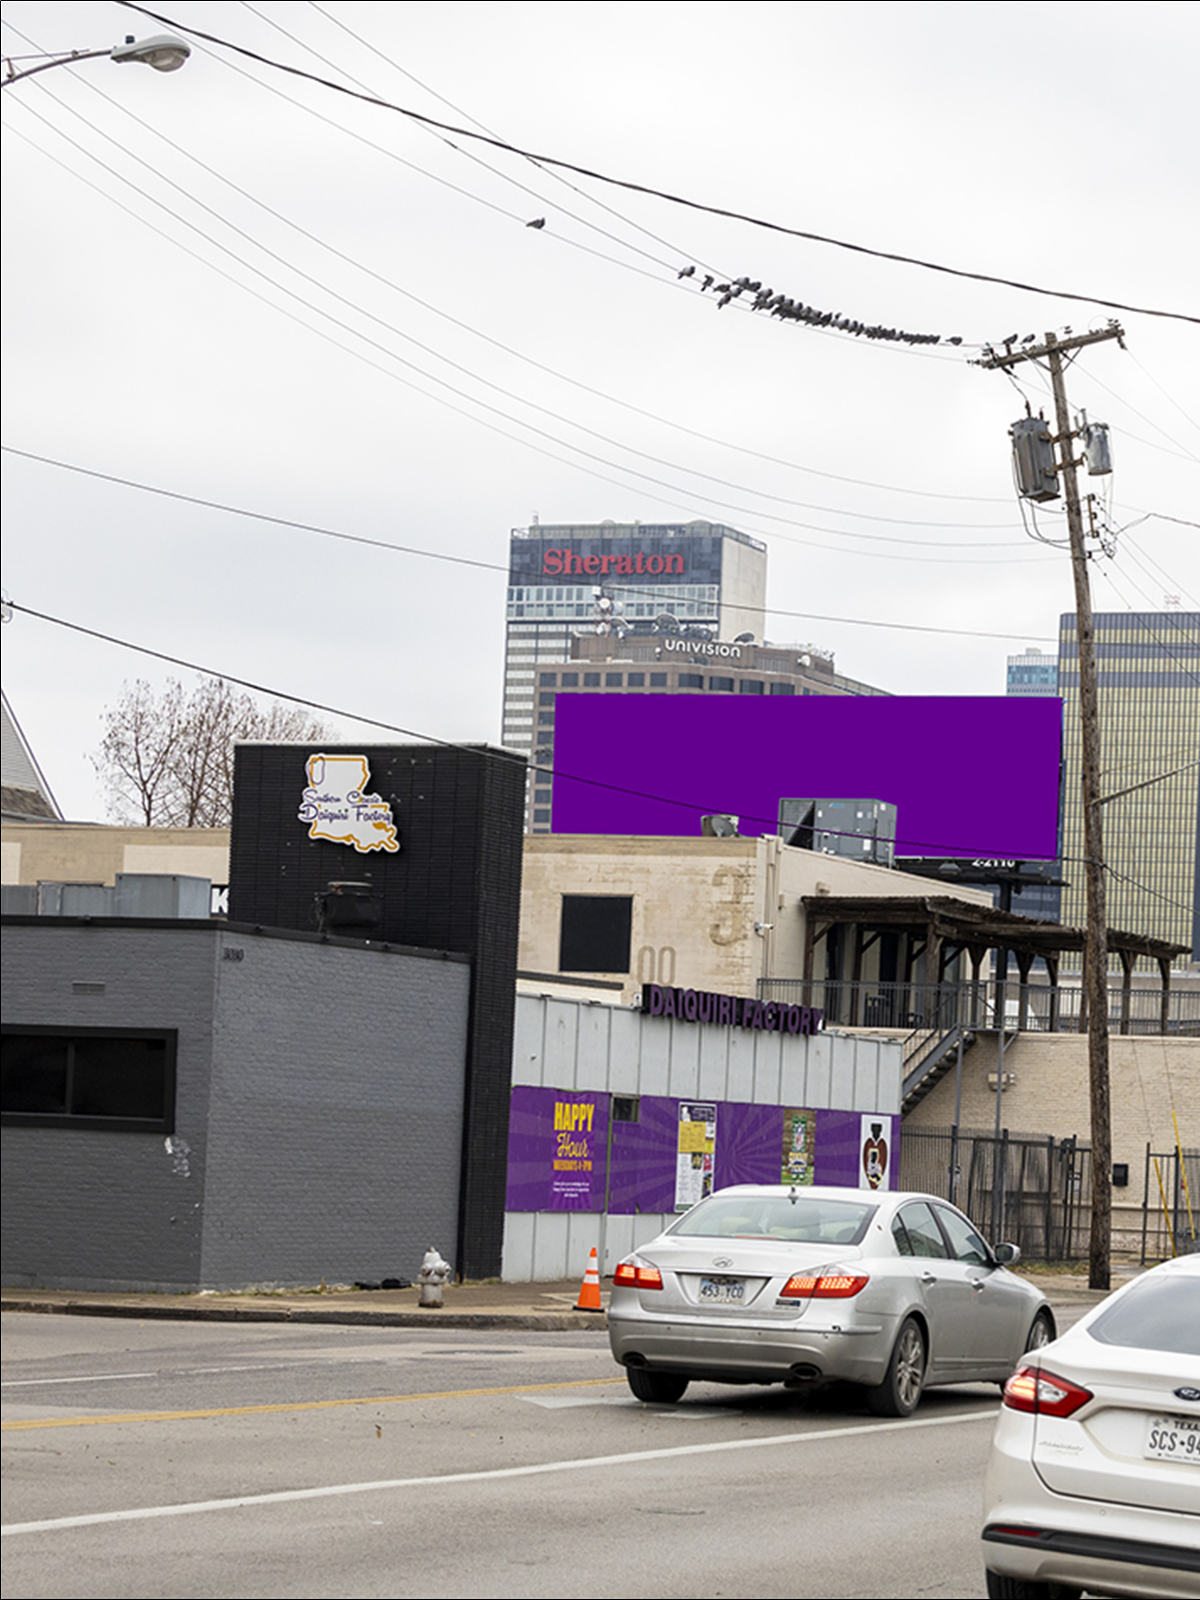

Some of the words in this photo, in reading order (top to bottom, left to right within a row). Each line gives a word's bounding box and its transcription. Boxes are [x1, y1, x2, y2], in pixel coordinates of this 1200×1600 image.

[543, 549, 685, 575] Sheraton
[301, 804, 349, 823] Daiquiri
[351, 804, 391, 825] Factory
[650, 984, 738, 1026] DAIQUIRI
[742, 998, 824, 1036] FACTORY
[554, 1102, 595, 1132] HAPPY
[557, 1133, 589, 1157] Hour
